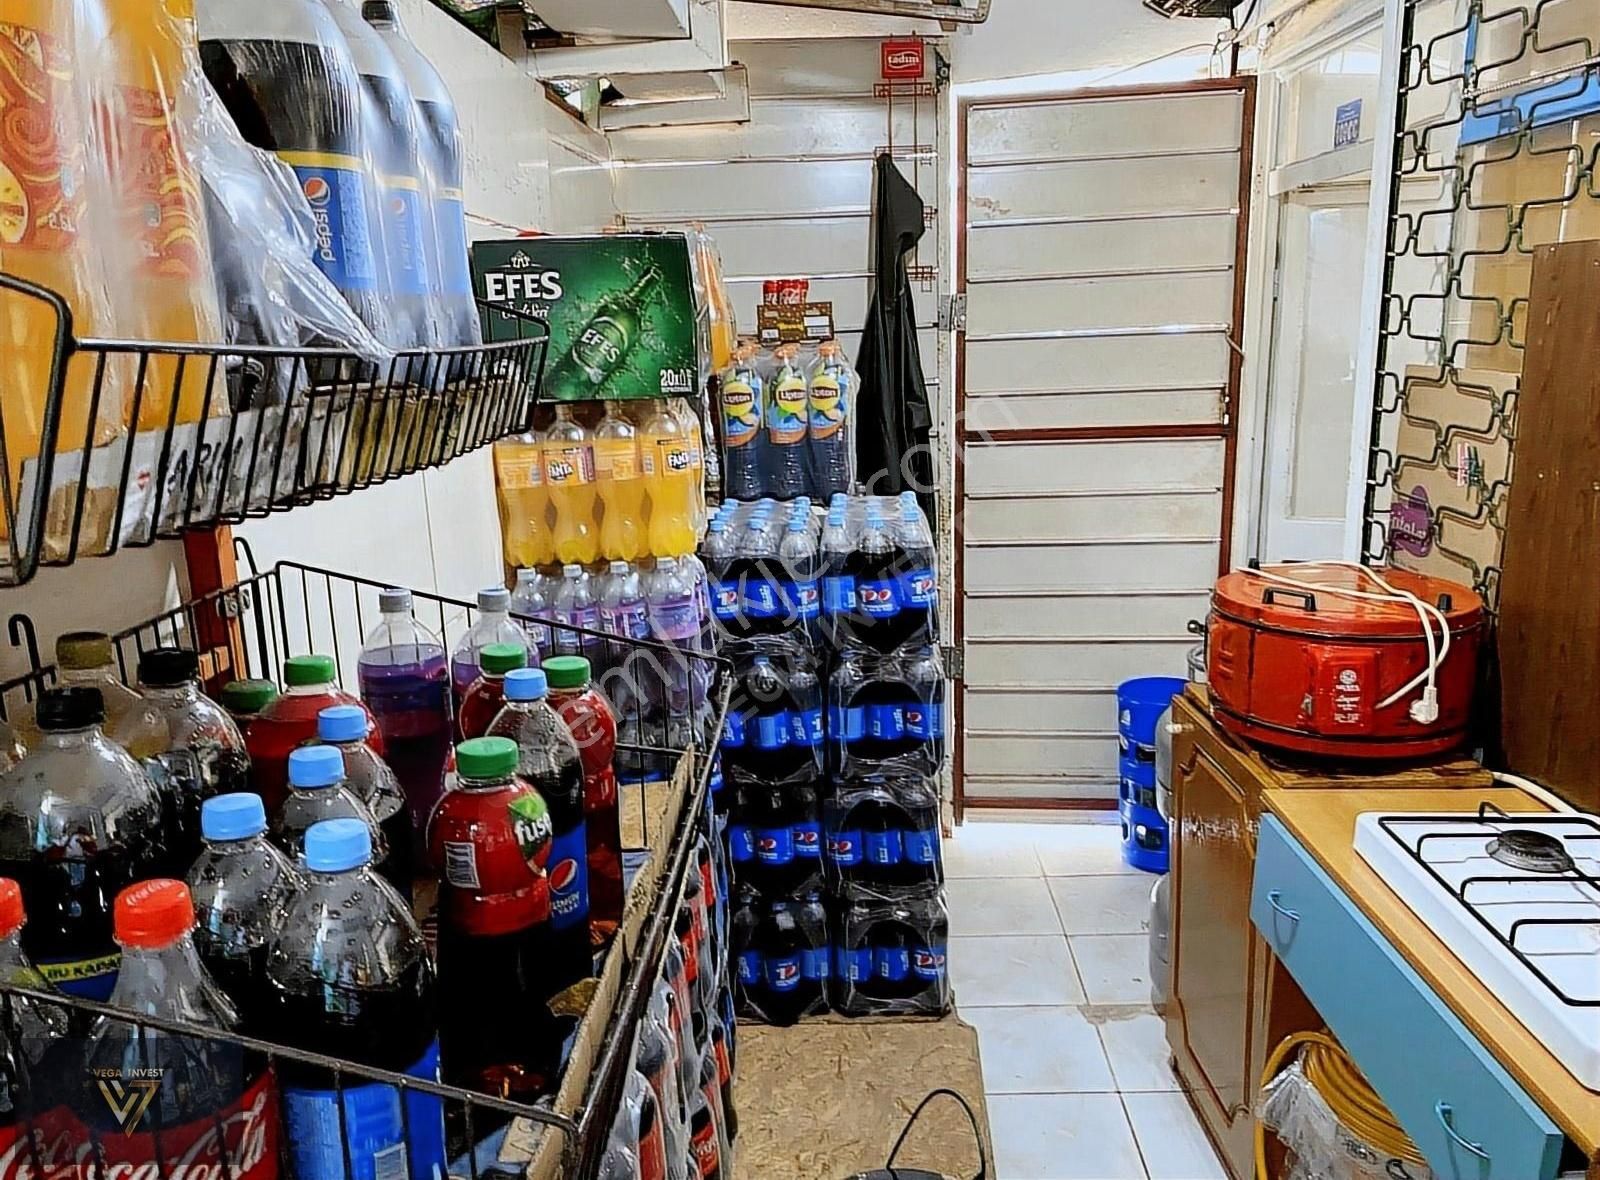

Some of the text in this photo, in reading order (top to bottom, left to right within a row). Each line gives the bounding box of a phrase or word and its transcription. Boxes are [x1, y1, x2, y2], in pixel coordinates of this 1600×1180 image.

[311, 208, 337, 262] pepsi
[484, 271, 563, 301] EFES
[580, 328, 621, 364] EFES
